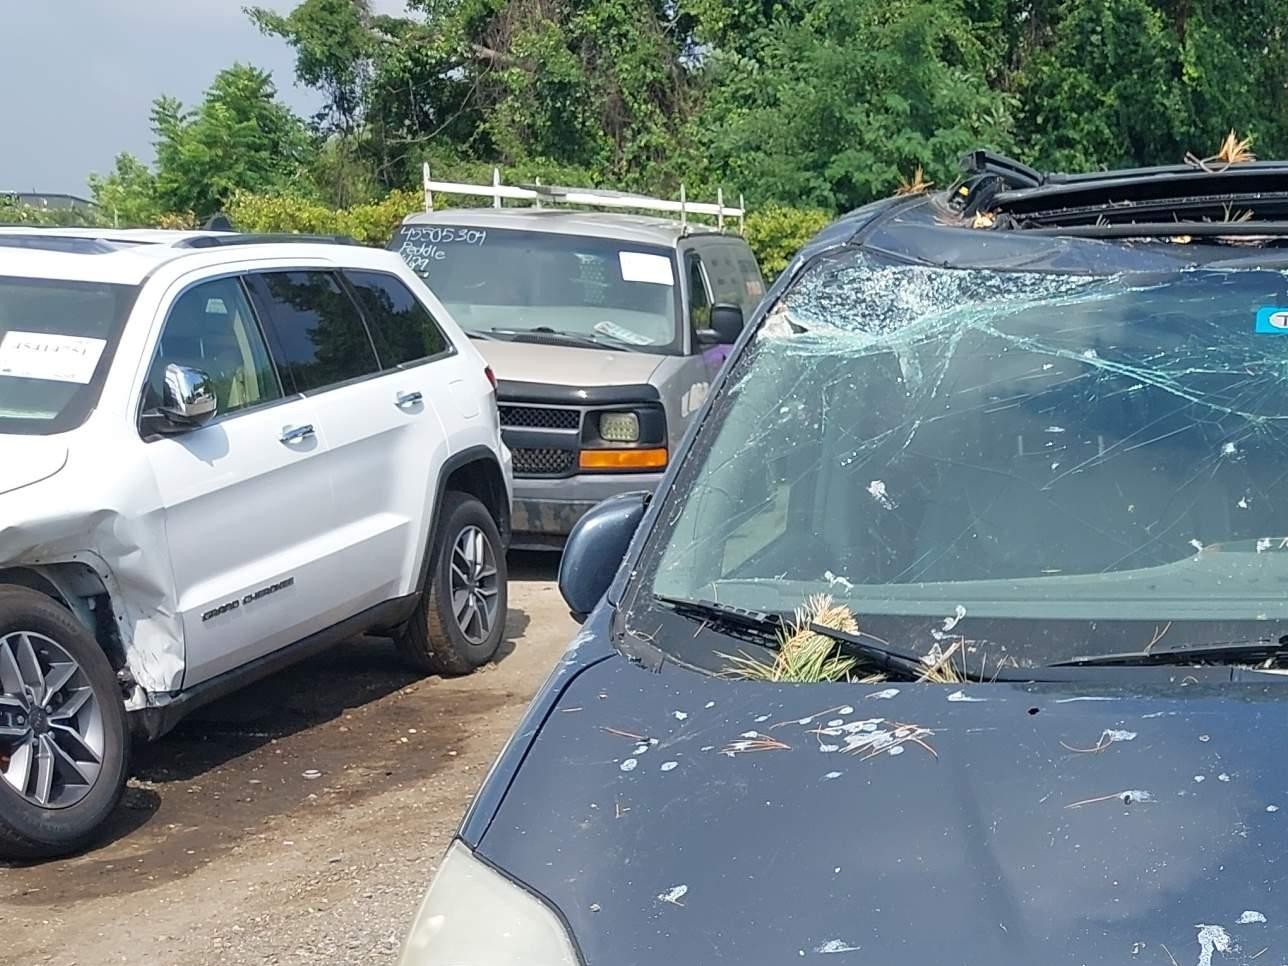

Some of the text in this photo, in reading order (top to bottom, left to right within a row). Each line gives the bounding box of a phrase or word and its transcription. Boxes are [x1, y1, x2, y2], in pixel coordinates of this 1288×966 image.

[399, 241, 446, 260] Peddle
[202, 576, 295, 622] GRAND CHEROKEE
